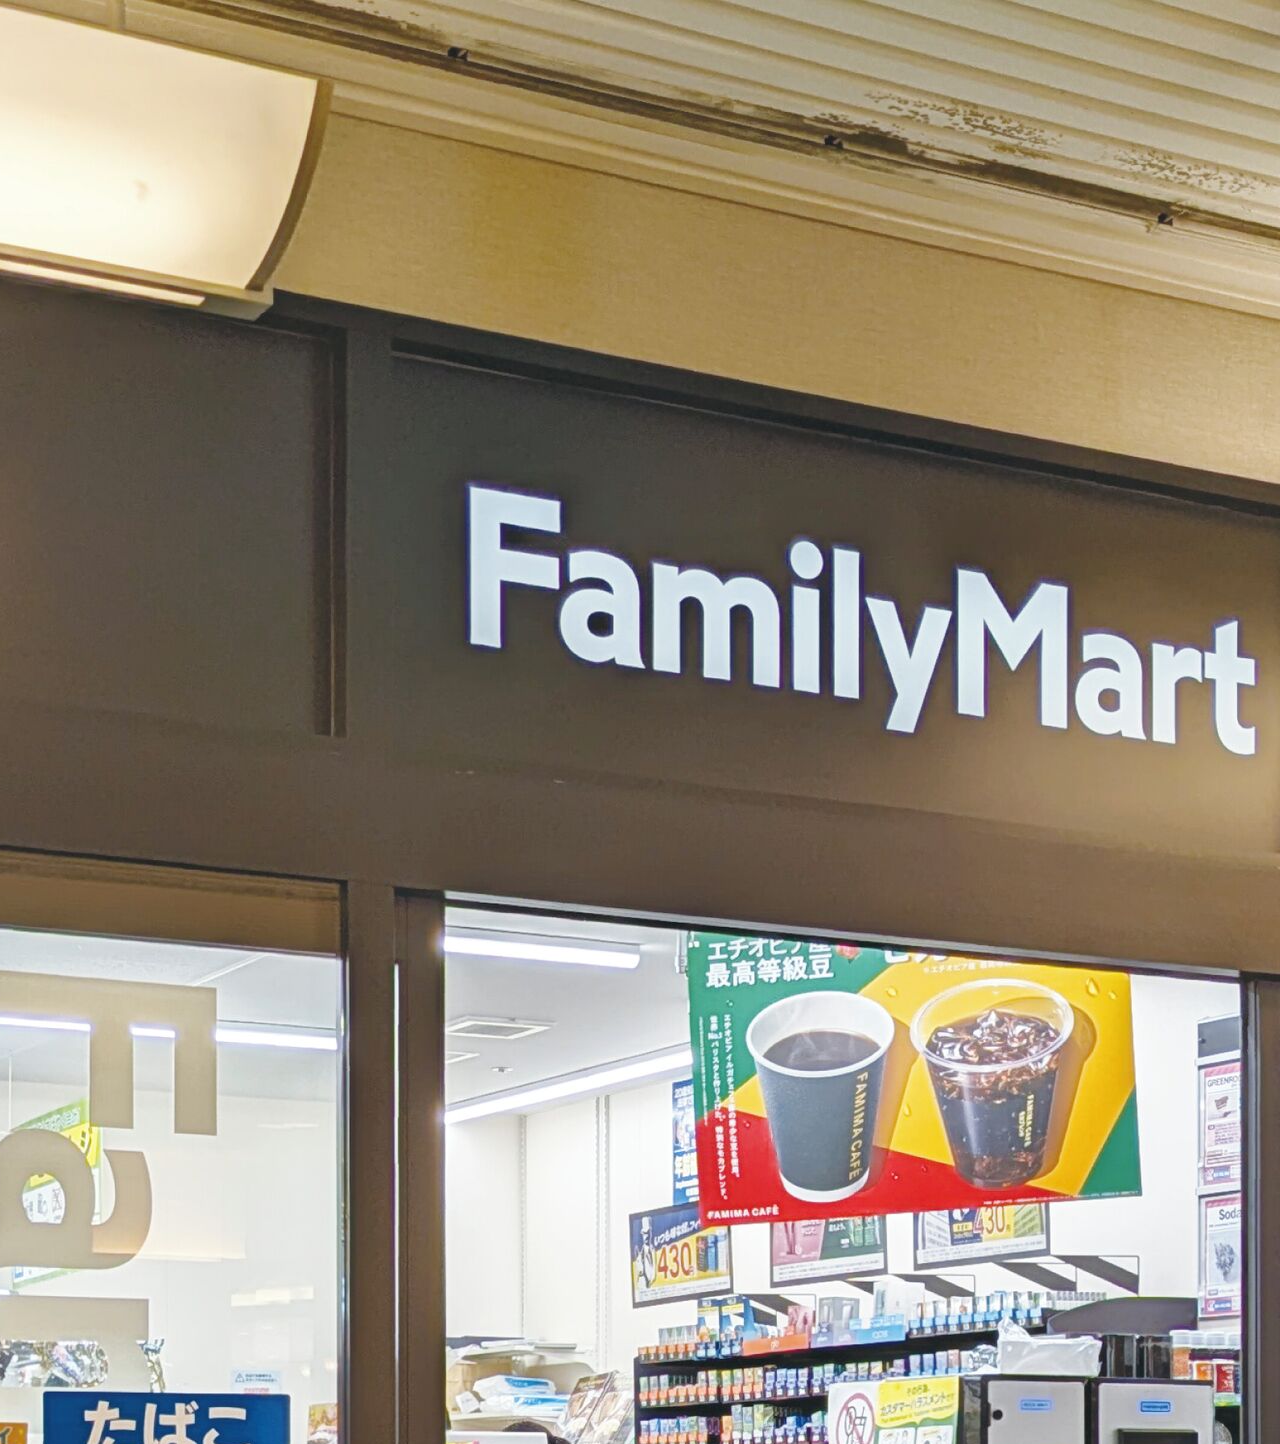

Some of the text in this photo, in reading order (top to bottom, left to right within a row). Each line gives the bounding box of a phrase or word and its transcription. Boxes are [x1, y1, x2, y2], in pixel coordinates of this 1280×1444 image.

[467, 483, 1257, 757] FamilyMart
[705, 956, 835, 988] 最高等級豆
[848, 1071, 869, 1181] FAMIMA CAFÉ
[707, 1204, 780, 1220] FAMIMA CAFÉ
